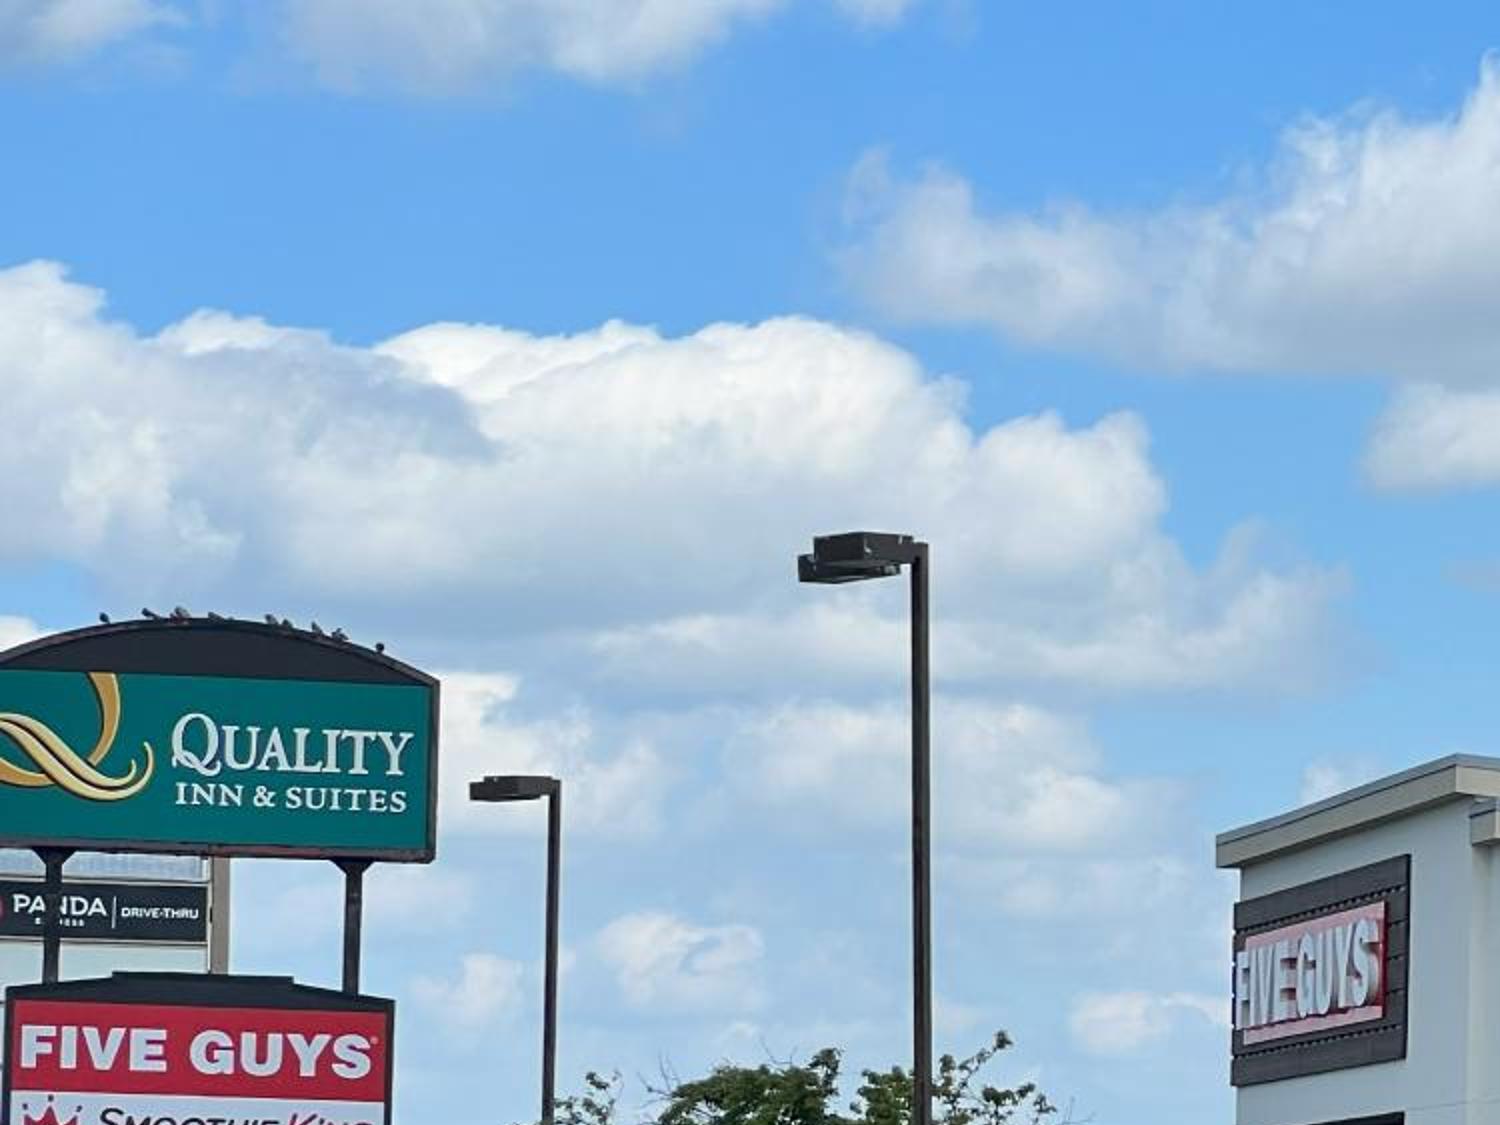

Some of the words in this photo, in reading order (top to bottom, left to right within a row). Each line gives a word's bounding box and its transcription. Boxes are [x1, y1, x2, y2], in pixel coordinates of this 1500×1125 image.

[172, 713, 414, 776] QUALITY
[175, 781, 242, 807] INN
[253, 786, 276, 808] &
[286, 786, 407, 813] SUITES
[1236, 940, 1292, 1030] FIVE
[1297, 918, 1382, 1017] GUYS
[20, 1024, 168, 1072] FIVE
[189, 1030, 372, 1080] GUYS
